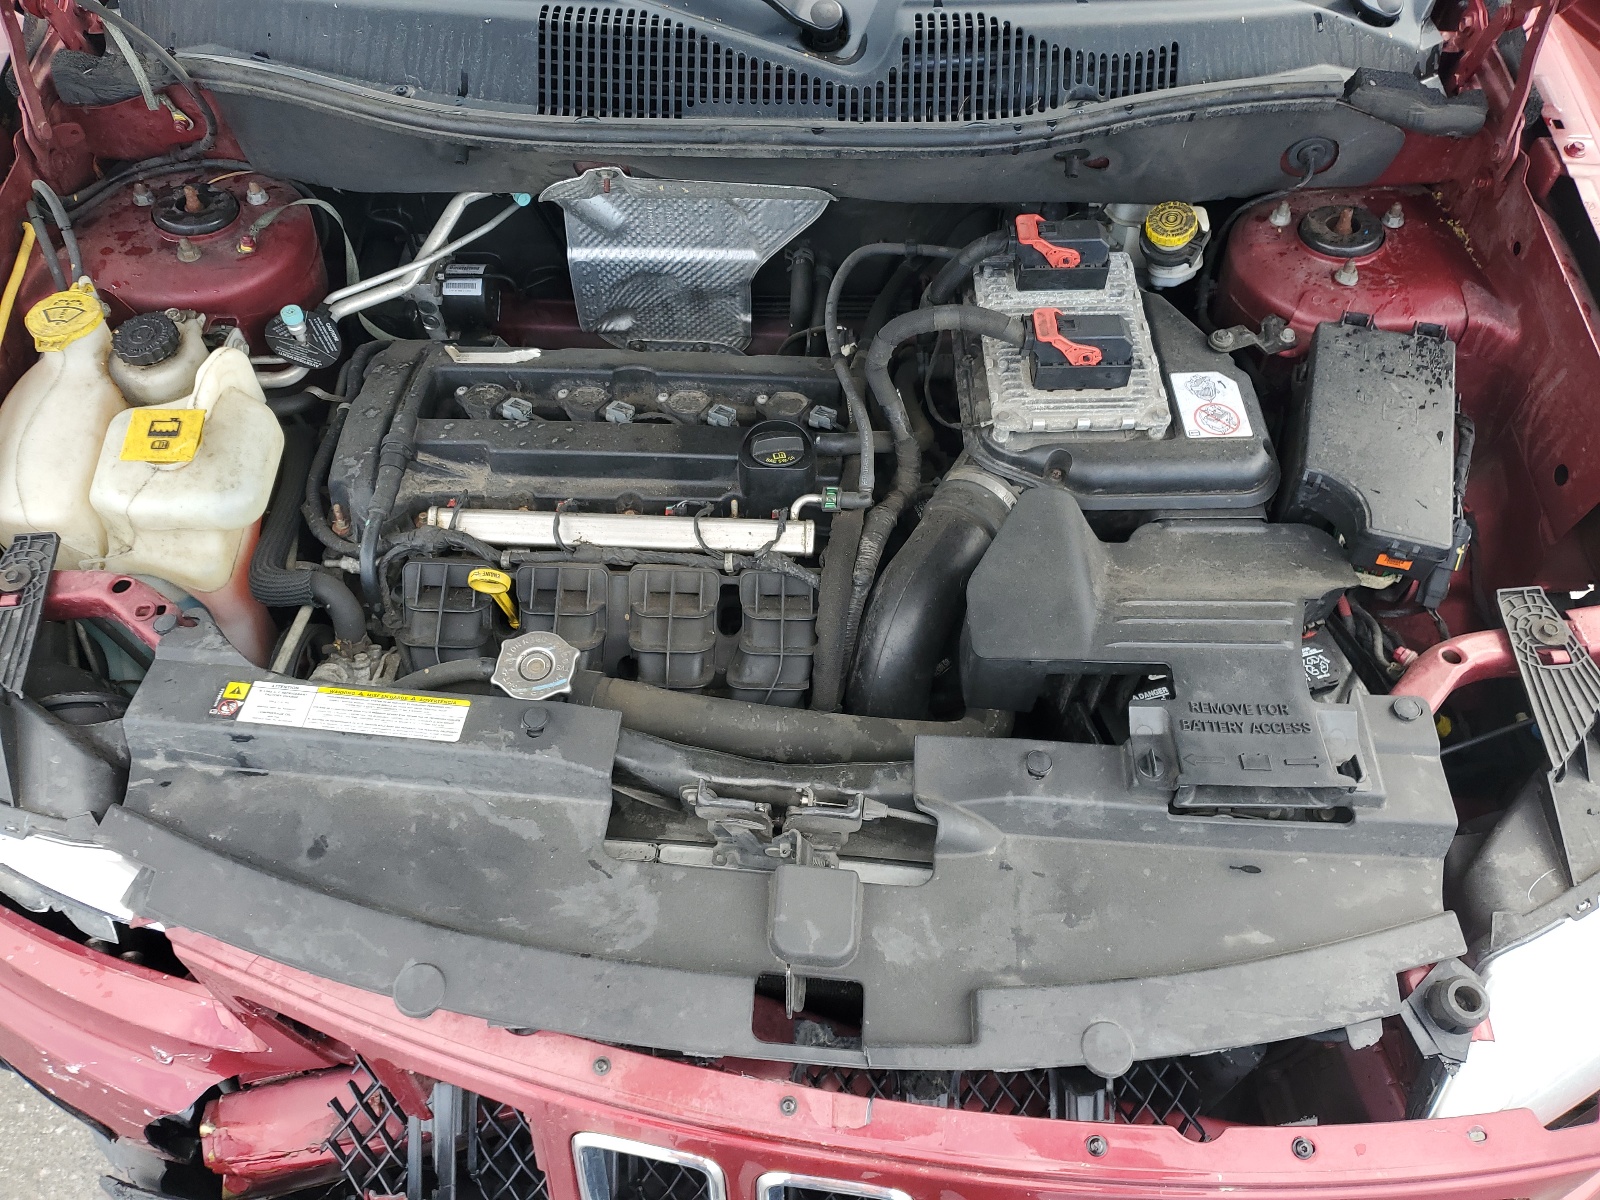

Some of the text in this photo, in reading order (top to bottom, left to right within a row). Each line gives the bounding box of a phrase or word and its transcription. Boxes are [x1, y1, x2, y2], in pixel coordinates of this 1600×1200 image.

[1138, 686, 1170, 700] DANGER
[1188, 700, 1289, 716] REMOVE FOR
[1180, 719, 1312, 735] BATTERY ACCESS
